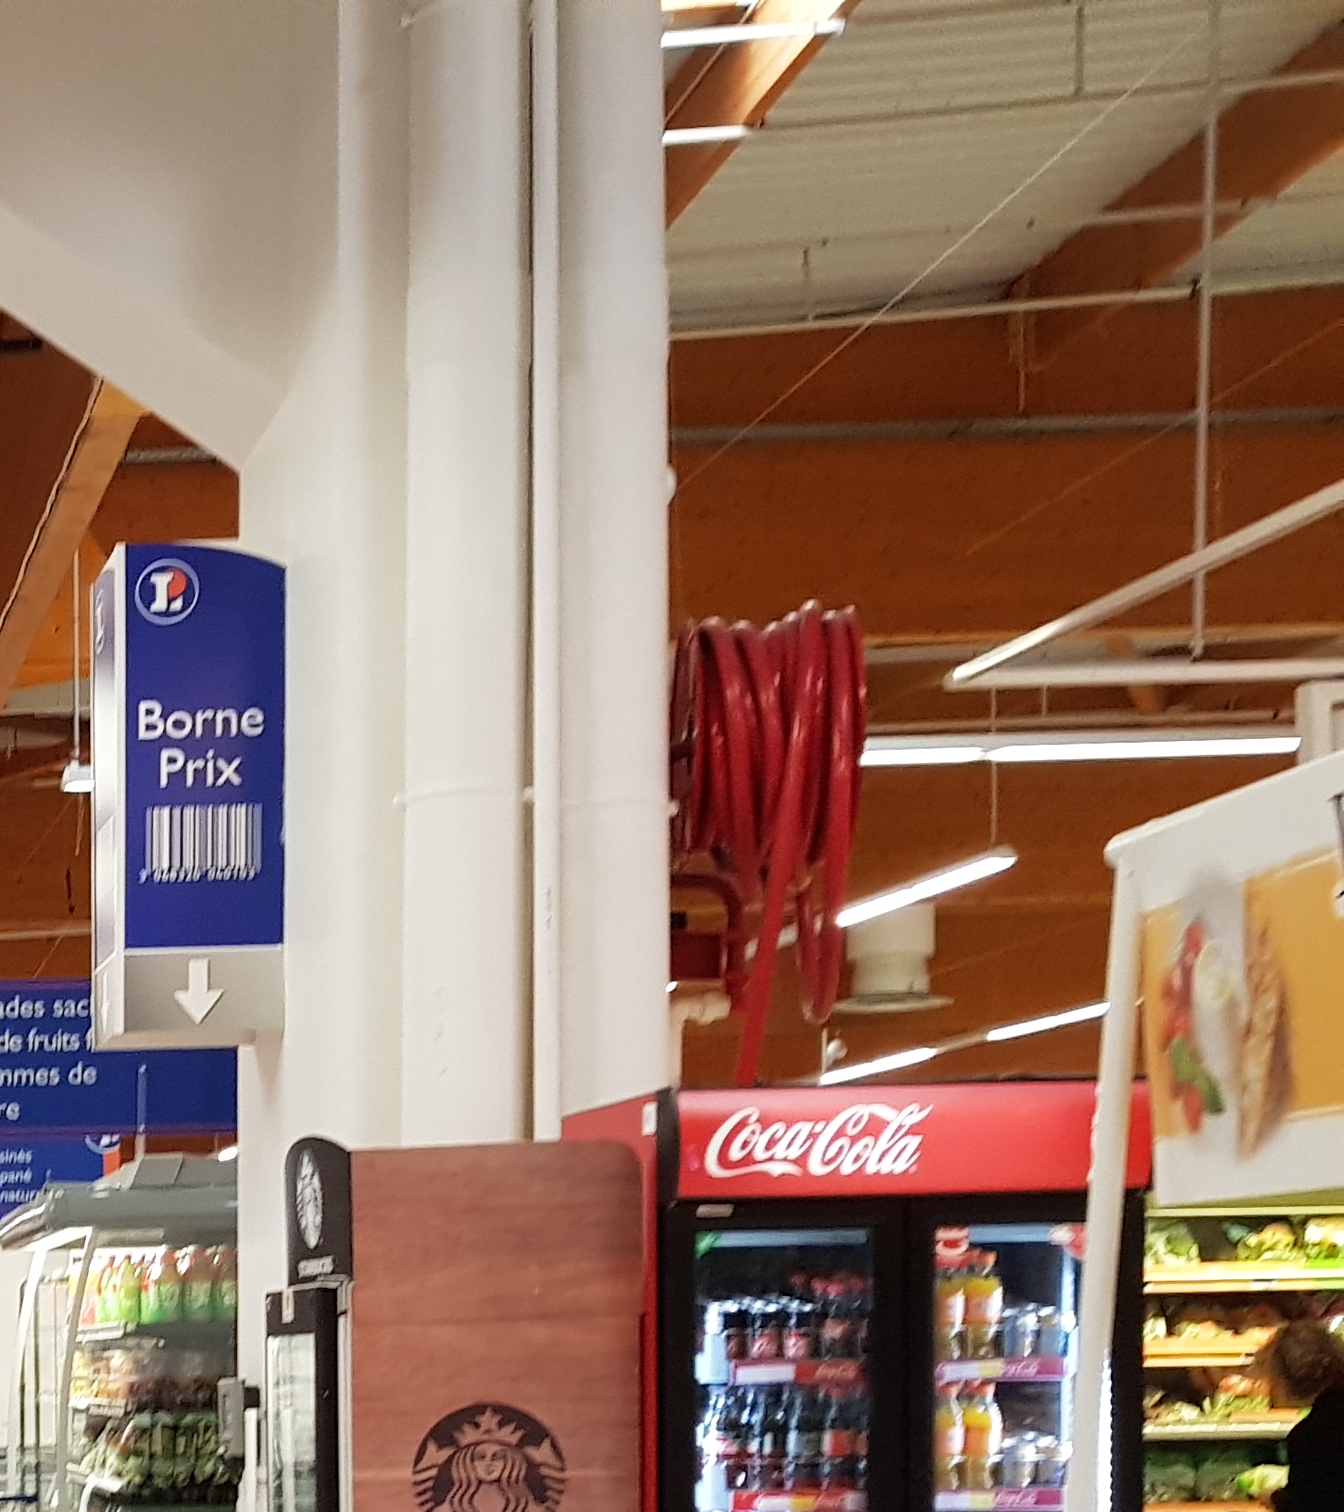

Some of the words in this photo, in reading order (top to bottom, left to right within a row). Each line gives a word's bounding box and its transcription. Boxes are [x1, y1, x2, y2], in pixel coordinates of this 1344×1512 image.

[138, 699, 265, 740] Borne
[160, 747, 243, 789] Prix
[27, 1027, 80, 1053] fruits
[67, 1060, 97, 1086] de
[704, 1102, 934, 1179] Coca-Cola
[0, 1166, 33, 1187] pané
